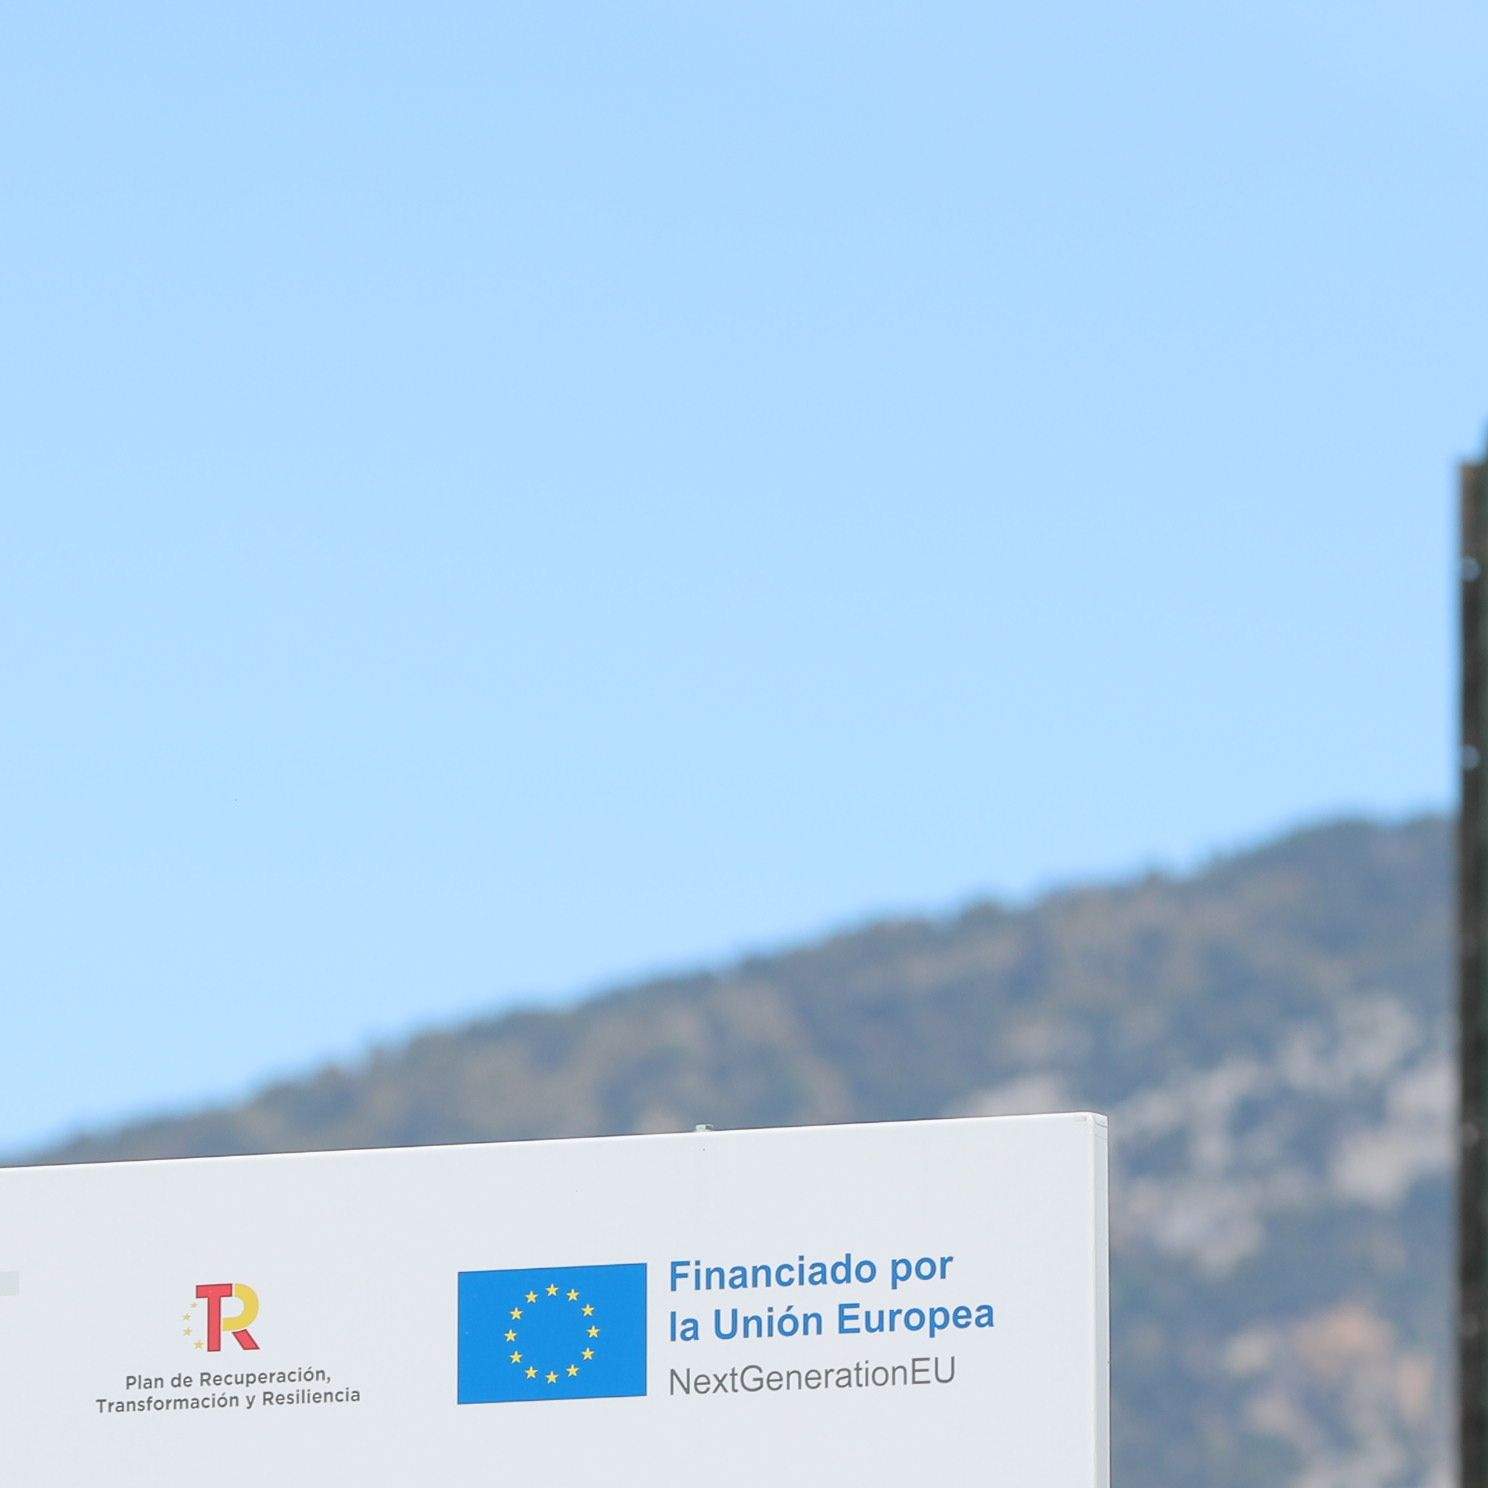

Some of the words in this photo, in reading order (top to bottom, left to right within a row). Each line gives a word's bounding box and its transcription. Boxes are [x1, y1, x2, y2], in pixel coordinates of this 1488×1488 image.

[670, 1252, 877, 1293] Financiado
[890, 1255, 955, 1291] por
[669, 1310, 700, 1343] la
[713, 1304, 823, 1341] Unión
[837, 1302, 995, 1339] Europea
[125, 1374, 164, 1391] Plan
[170, 1372, 194, 1389] de
[199, 1366, 332, 1387] Recuperación,
[669, 1355, 956, 1396] NextGenerationEU
[95, 1393, 241, 1414] Transformación
[245, 1395, 257, 1411] y
[263, 1387, 361, 1407] Resiliencia
